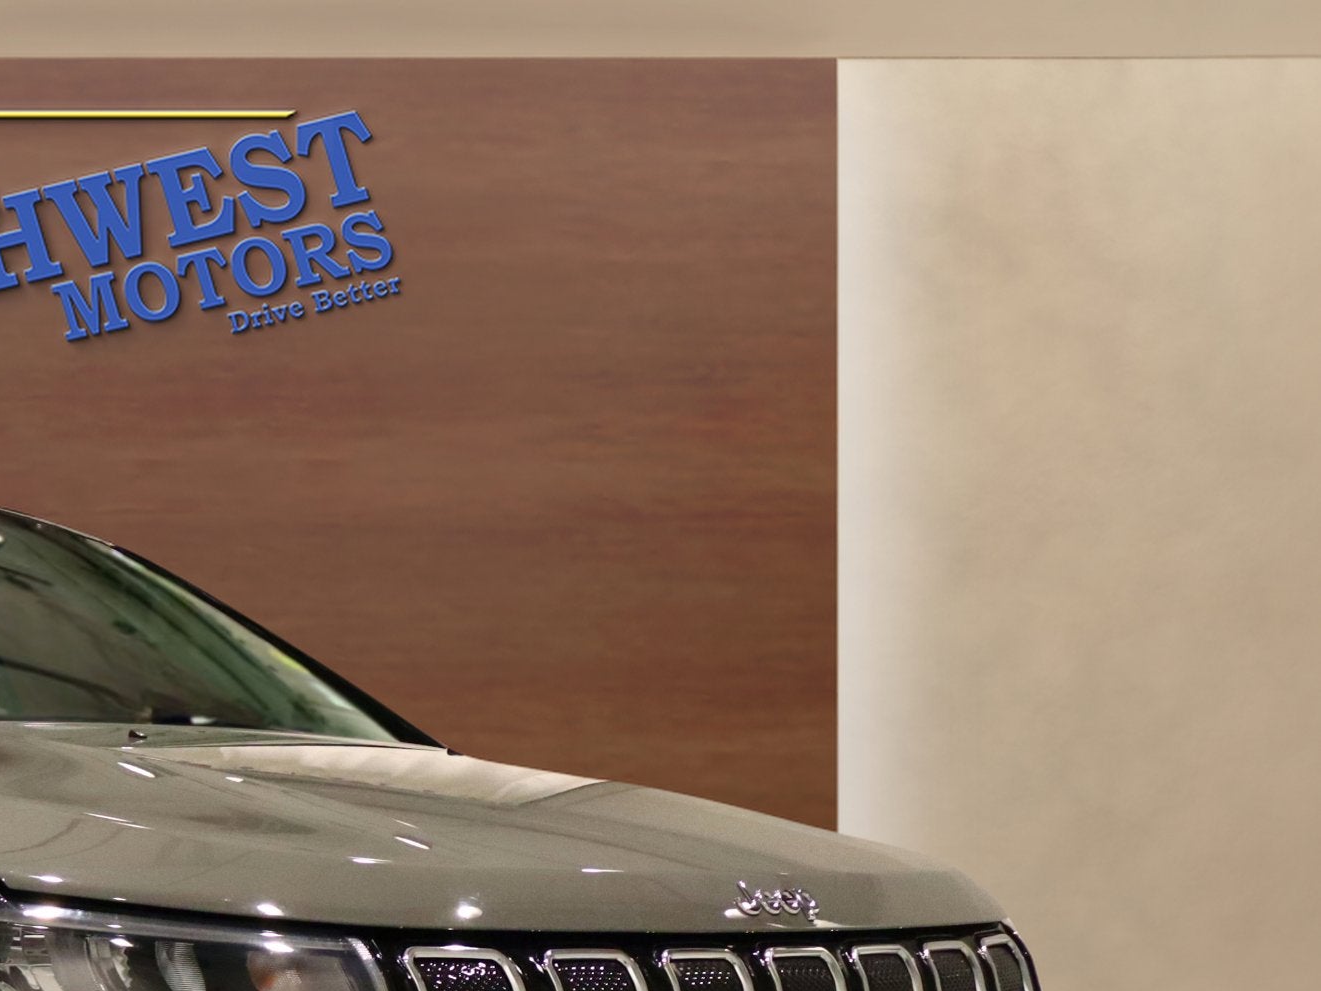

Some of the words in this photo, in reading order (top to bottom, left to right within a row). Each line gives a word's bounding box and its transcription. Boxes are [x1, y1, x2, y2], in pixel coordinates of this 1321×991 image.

[51, 210, 393, 341] MOTORS
[228, 303, 305, 334] Drive
[312, 275, 401, 314] Better
[734, 880, 819, 921] Jeep
